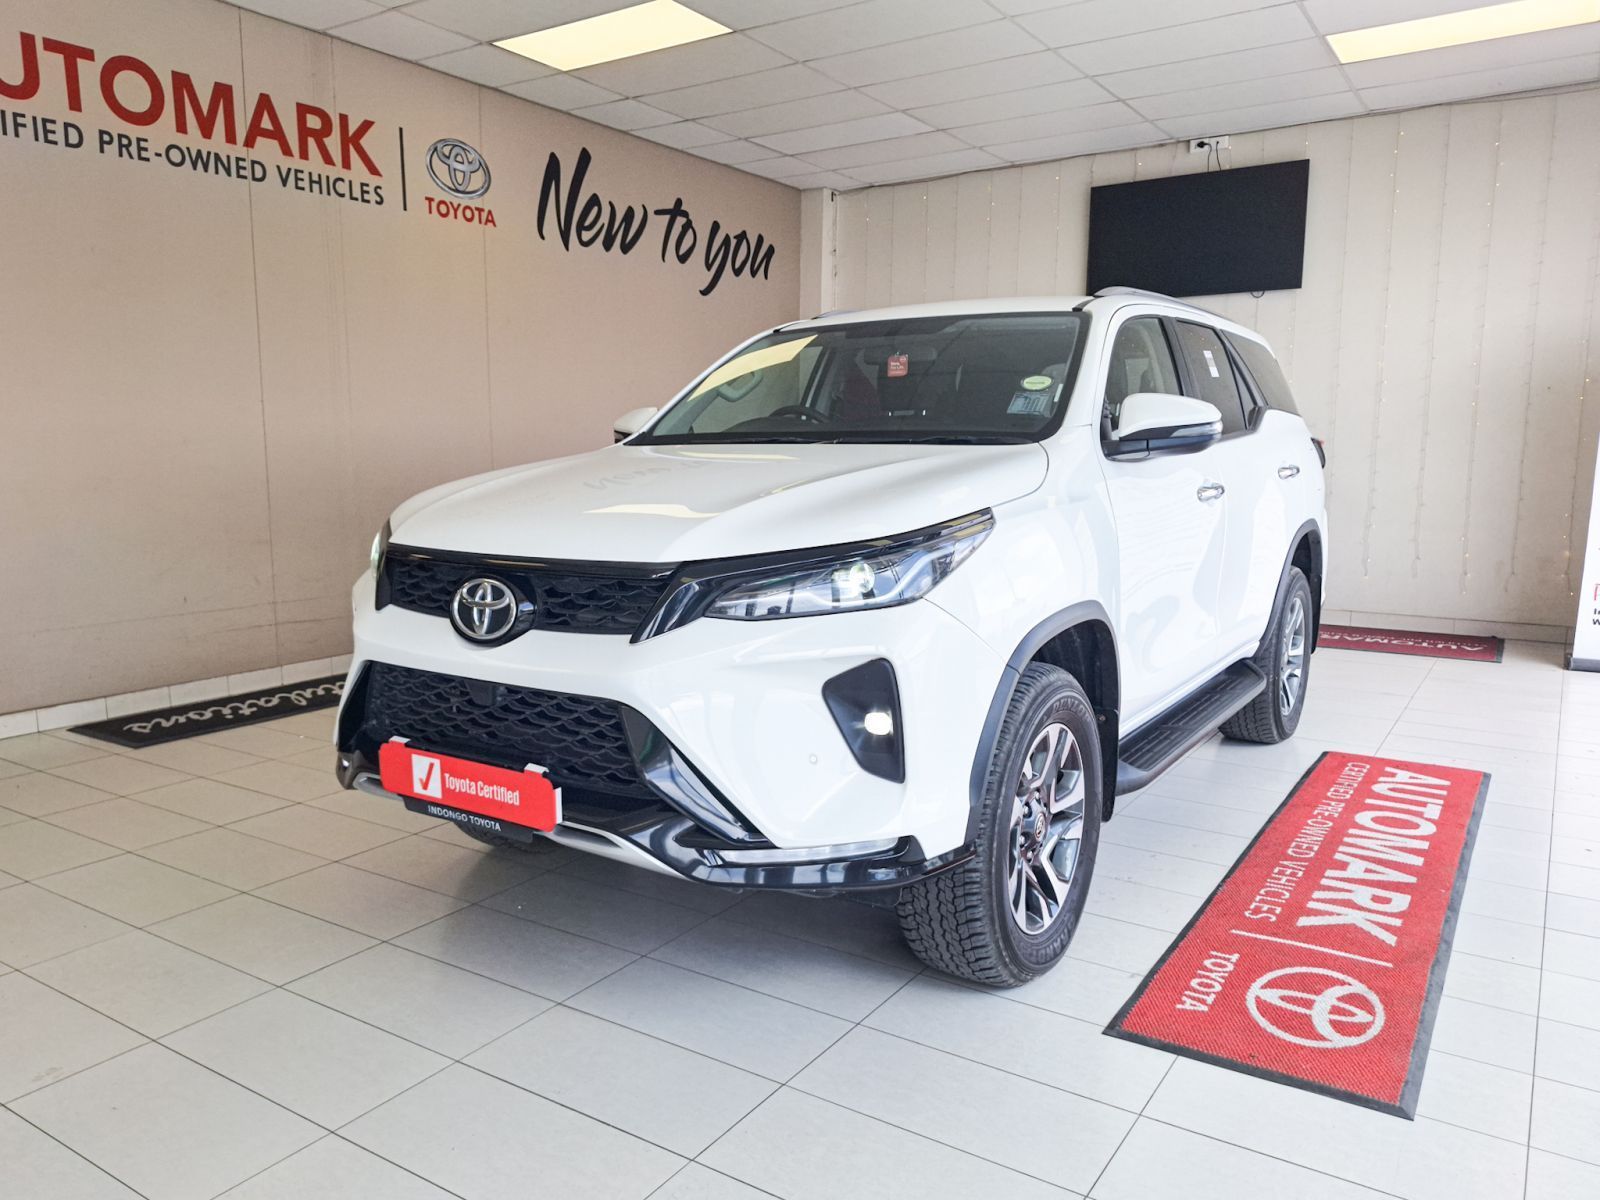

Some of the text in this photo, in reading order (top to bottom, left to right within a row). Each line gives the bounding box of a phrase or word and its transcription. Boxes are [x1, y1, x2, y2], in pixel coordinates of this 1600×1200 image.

[0, 31, 383, 178] UTOMARK
[0, 109, 384, 206] IFIED PRE-OWNED VEHICLES
[424, 196, 497, 228] TOYOTA
[537, 147, 776, 296] New to you
[428, 804, 502, 831] INDONGO TOYOTA
[444, 773, 520, 806] Toyota Certified
[1244, 761, 1371, 923] CERTIFIED PRE-OWNED VEHICLES
[1296, 766, 1452, 948] AUTOMARK
[1175, 951, 1241, 1013] TOYOTA
